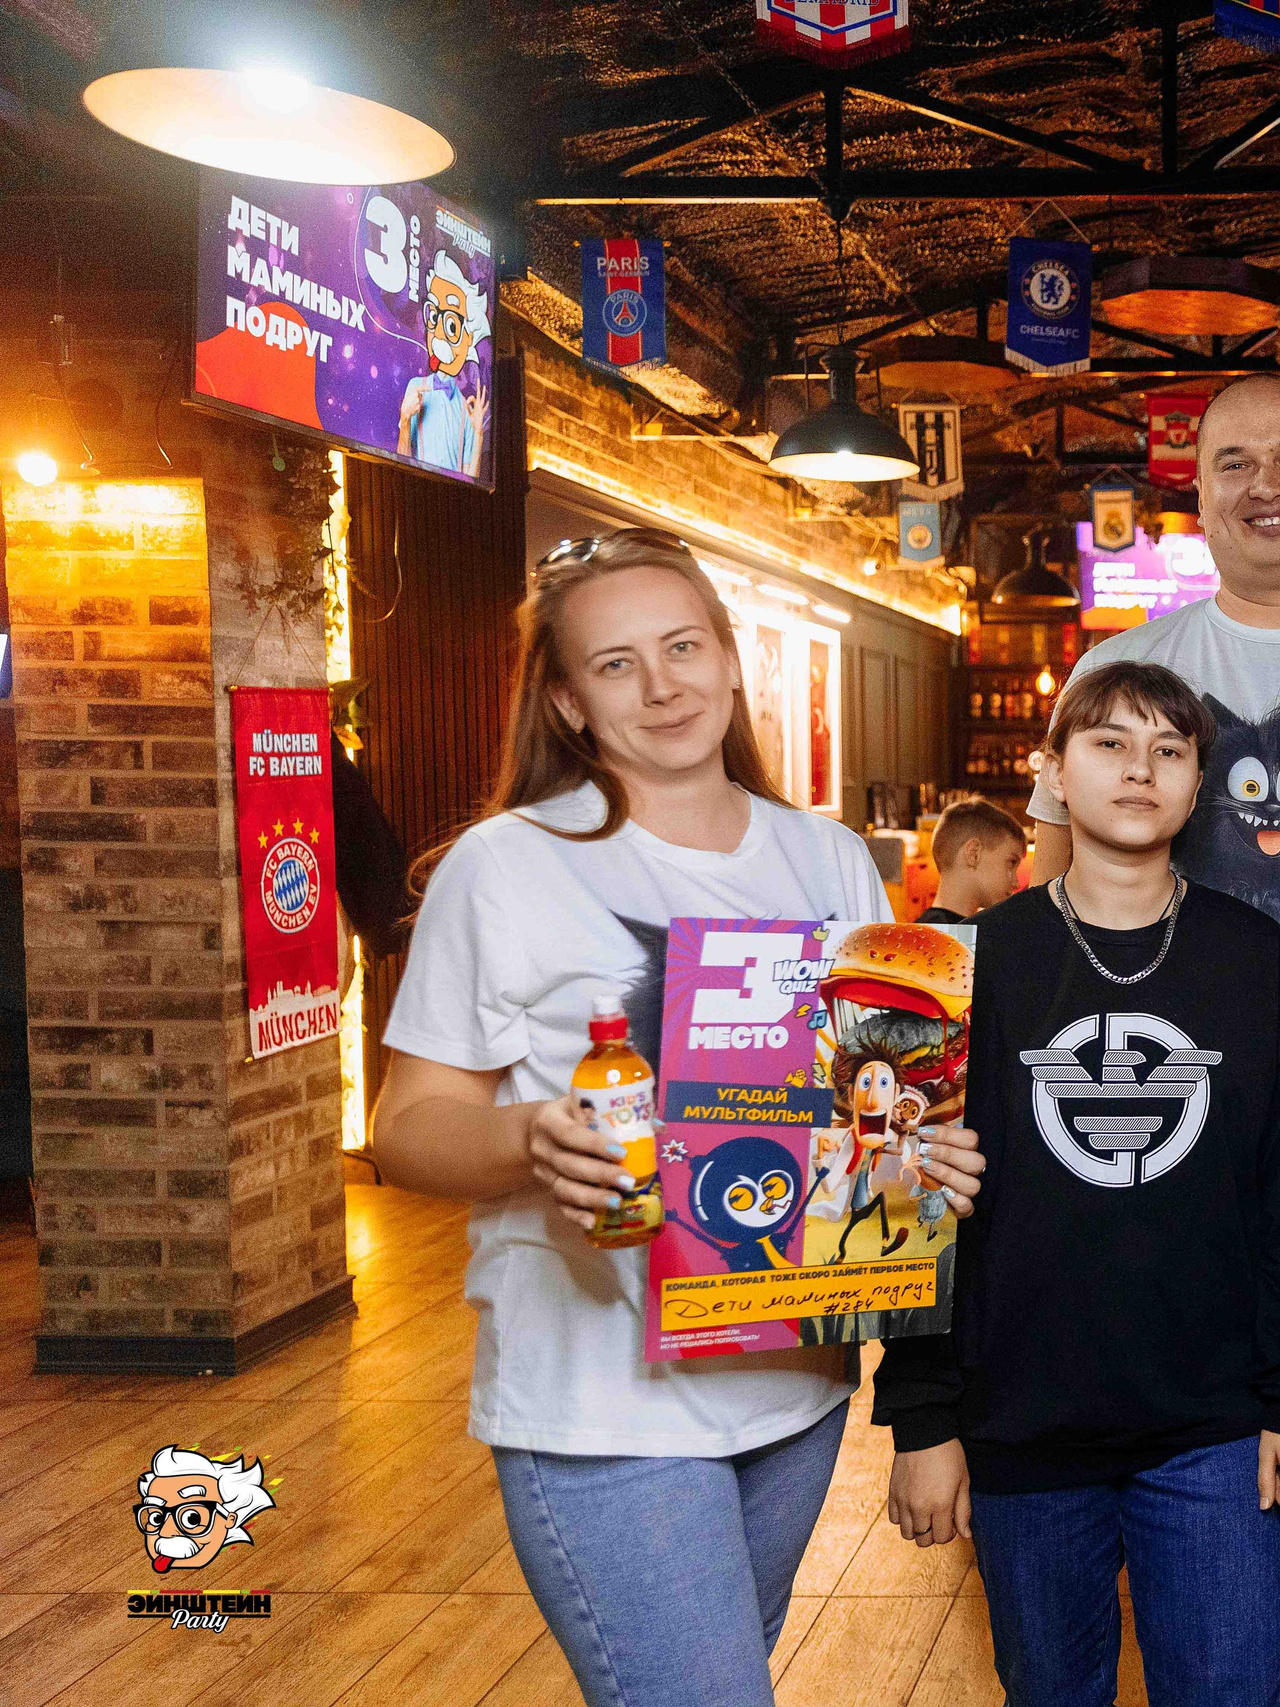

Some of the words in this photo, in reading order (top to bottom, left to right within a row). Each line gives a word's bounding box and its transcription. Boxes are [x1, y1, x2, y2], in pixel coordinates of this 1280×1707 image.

[227, 195, 299, 256] ДЕТИ
[364, 195, 408, 294] 3
[408, 214, 421, 303] МЕСТО
[596, 256, 650, 271] PARIS
[227, 245, 366, 332] МАМИНЫХ
[226, 295, 332, 363] ПОДРУГ
[252, 729, 318, 753] MÜNCHEN
[249, 755, 266, 777] FC
[269, 755, 323, 777] BAYERN
[265, 858, 278, 879] FC
[276, 843, 315, 872] BAYERN
[691, 931, 805, 1024] 3
[773, 958, 836, 981] WOW
[779, 980, 819, 995] QUIZ
[258, 1003, 336, 1051] MÜNCHEN
[688, 1026, 789, 1050] МЕСТО
[717, 1087, 788, 1104] УГАДАЙ
[601, 1102, 651, 1128] TOYS
[683, 1105, 814, 1123] МУЛЬТФИЛЬМ
[721, 1276, 766, 1287] КОТОРАЯ
[770, 1273, 797, 1283] ТОЖЕ
[799, 1270, 830, 1280] СКОРО
[832, 1266, 868, 1278] ЗАЙМЁТ
[870, 1264, 904, 1275] ПЕРВОЕ
[905, 1262, 935, 1272] МЕСТО
[664, 1299, 752, 1318] Дети
[872, 1281, 934, 1306] подруг
